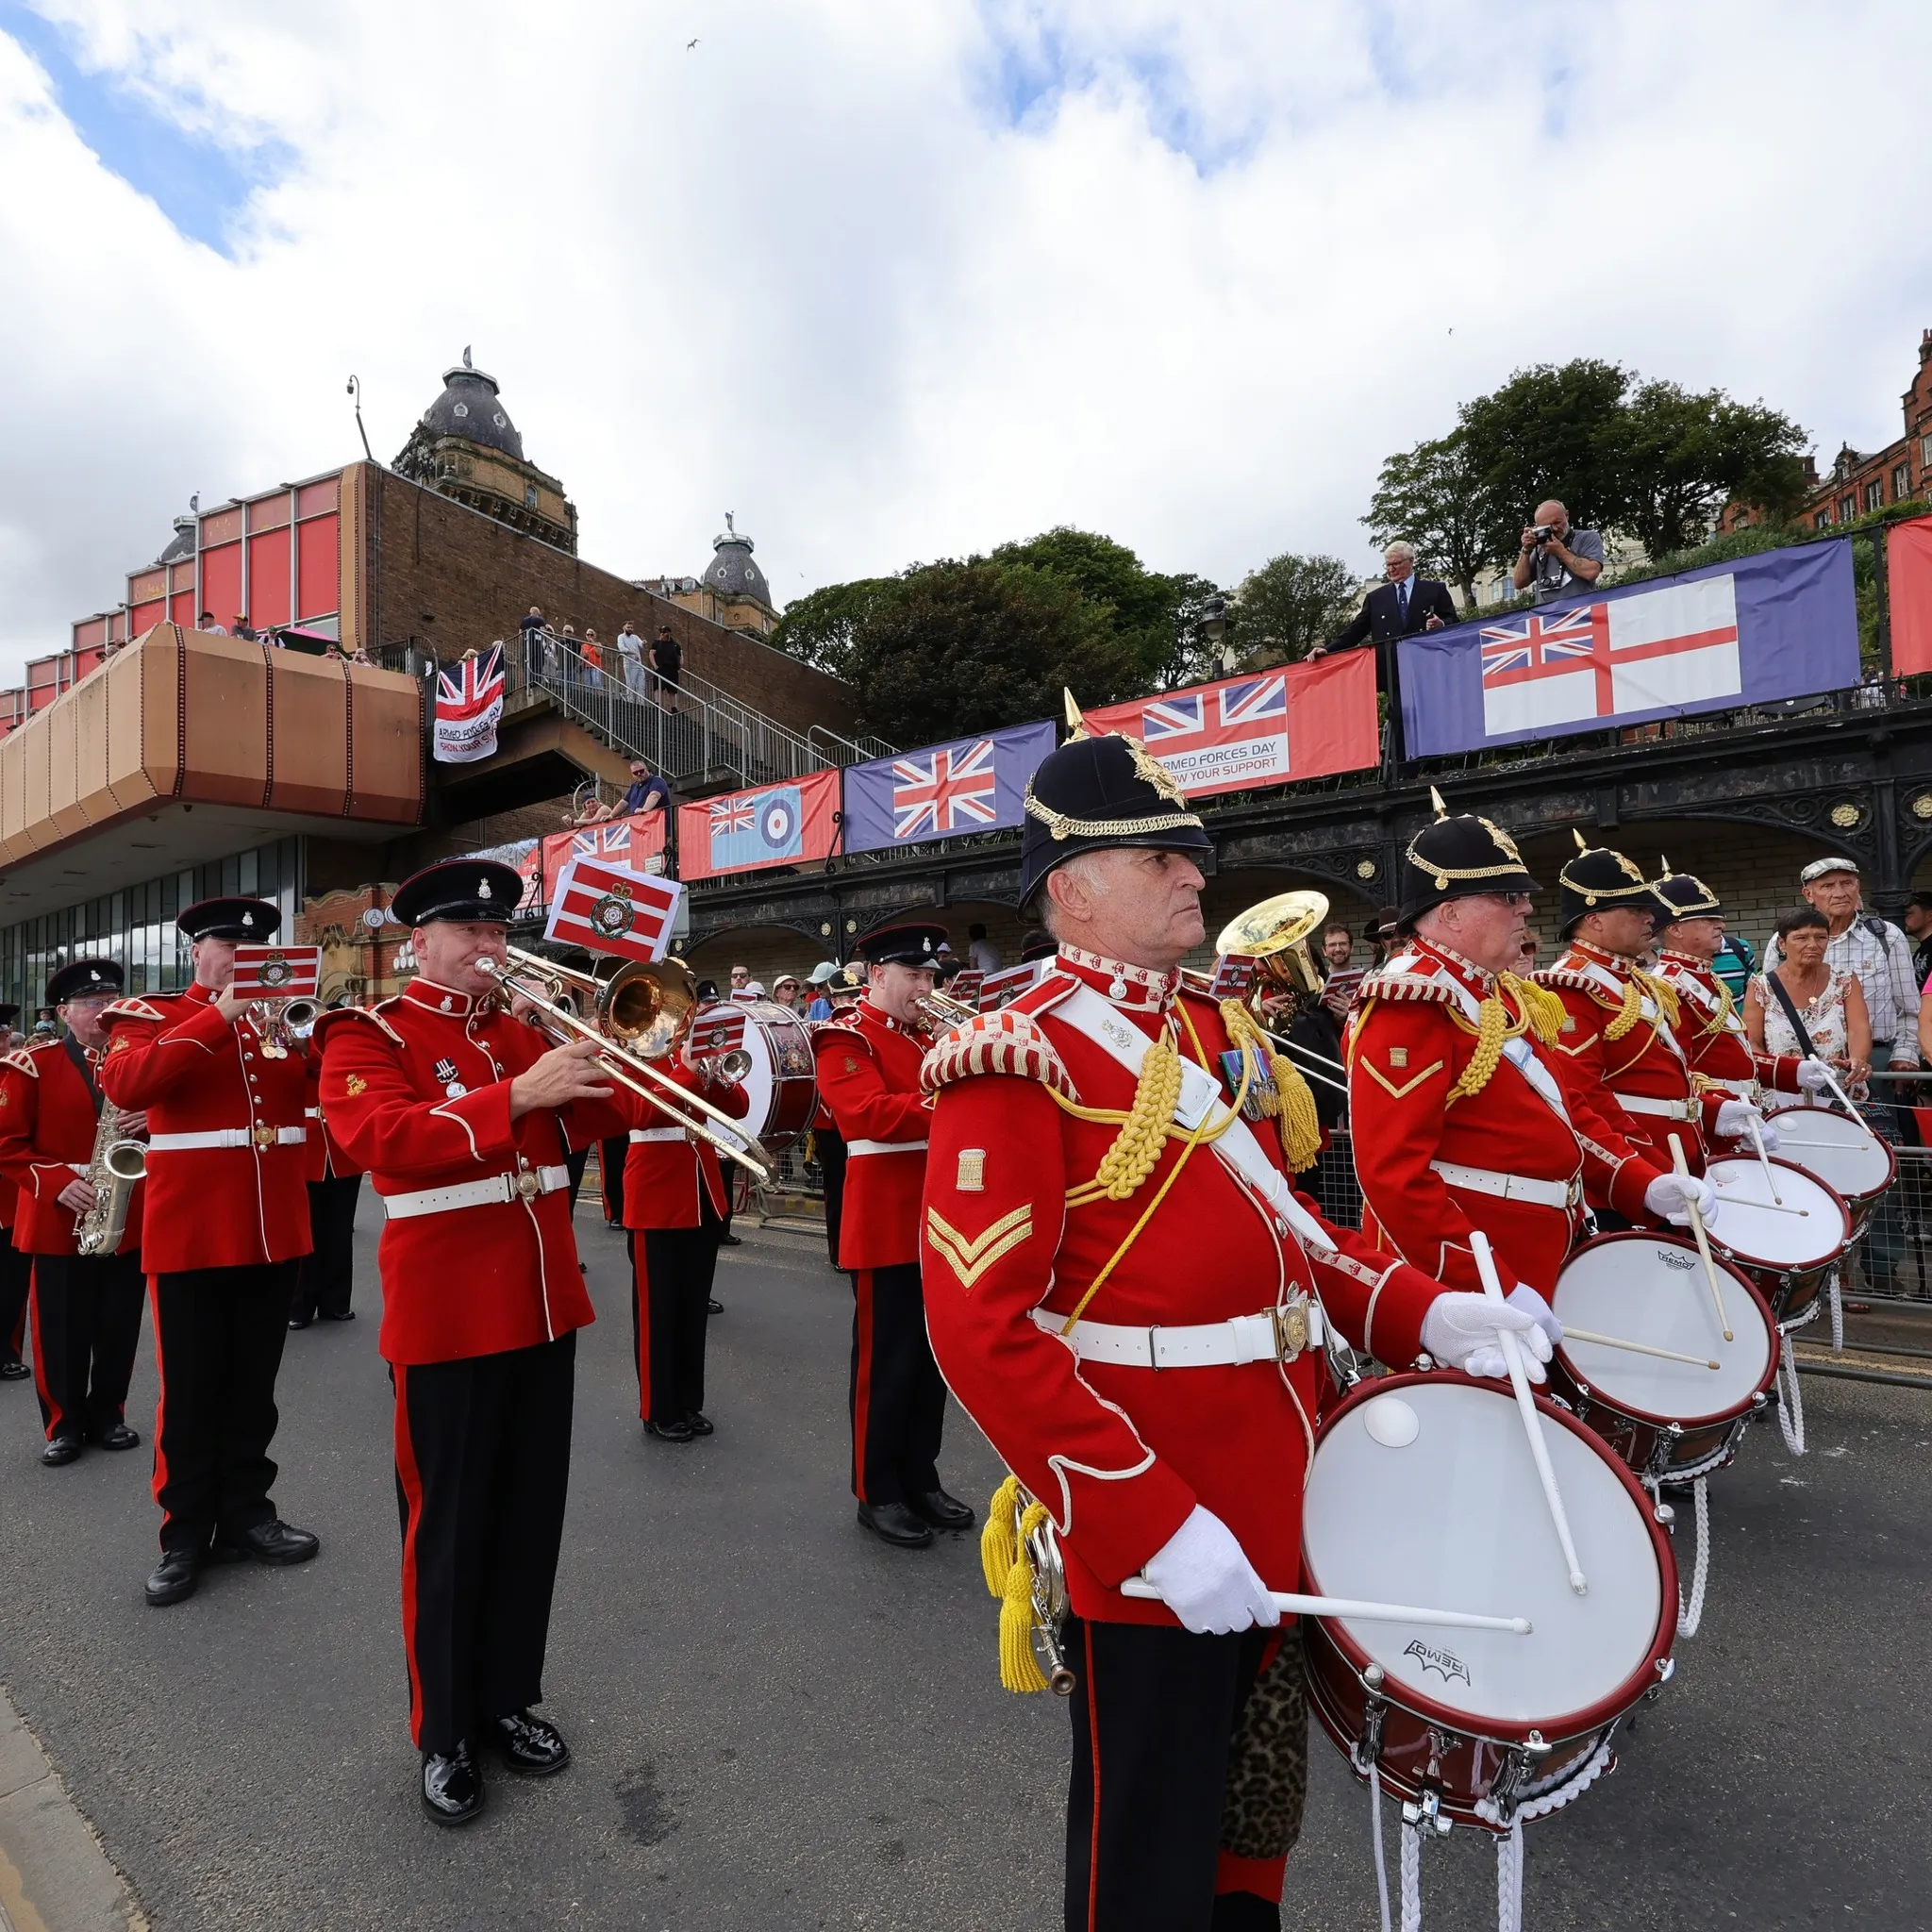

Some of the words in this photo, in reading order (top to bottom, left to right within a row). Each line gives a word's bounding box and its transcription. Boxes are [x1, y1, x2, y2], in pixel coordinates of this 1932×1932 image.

[459, 740, 483, 752] YOUR
[1162, 757, 1196, 770] RMED
[1200, 747, 1247, 764] FORCES
[1252, 741, 1276, 755] DAY
[1191, 768, 1220, 781] YOUR
[1223, 757, 1277, 775] SUPPORT
[1662, 1256, 1689, 1268] REMO
[1416, 1644, 1462, 1673] REMO
